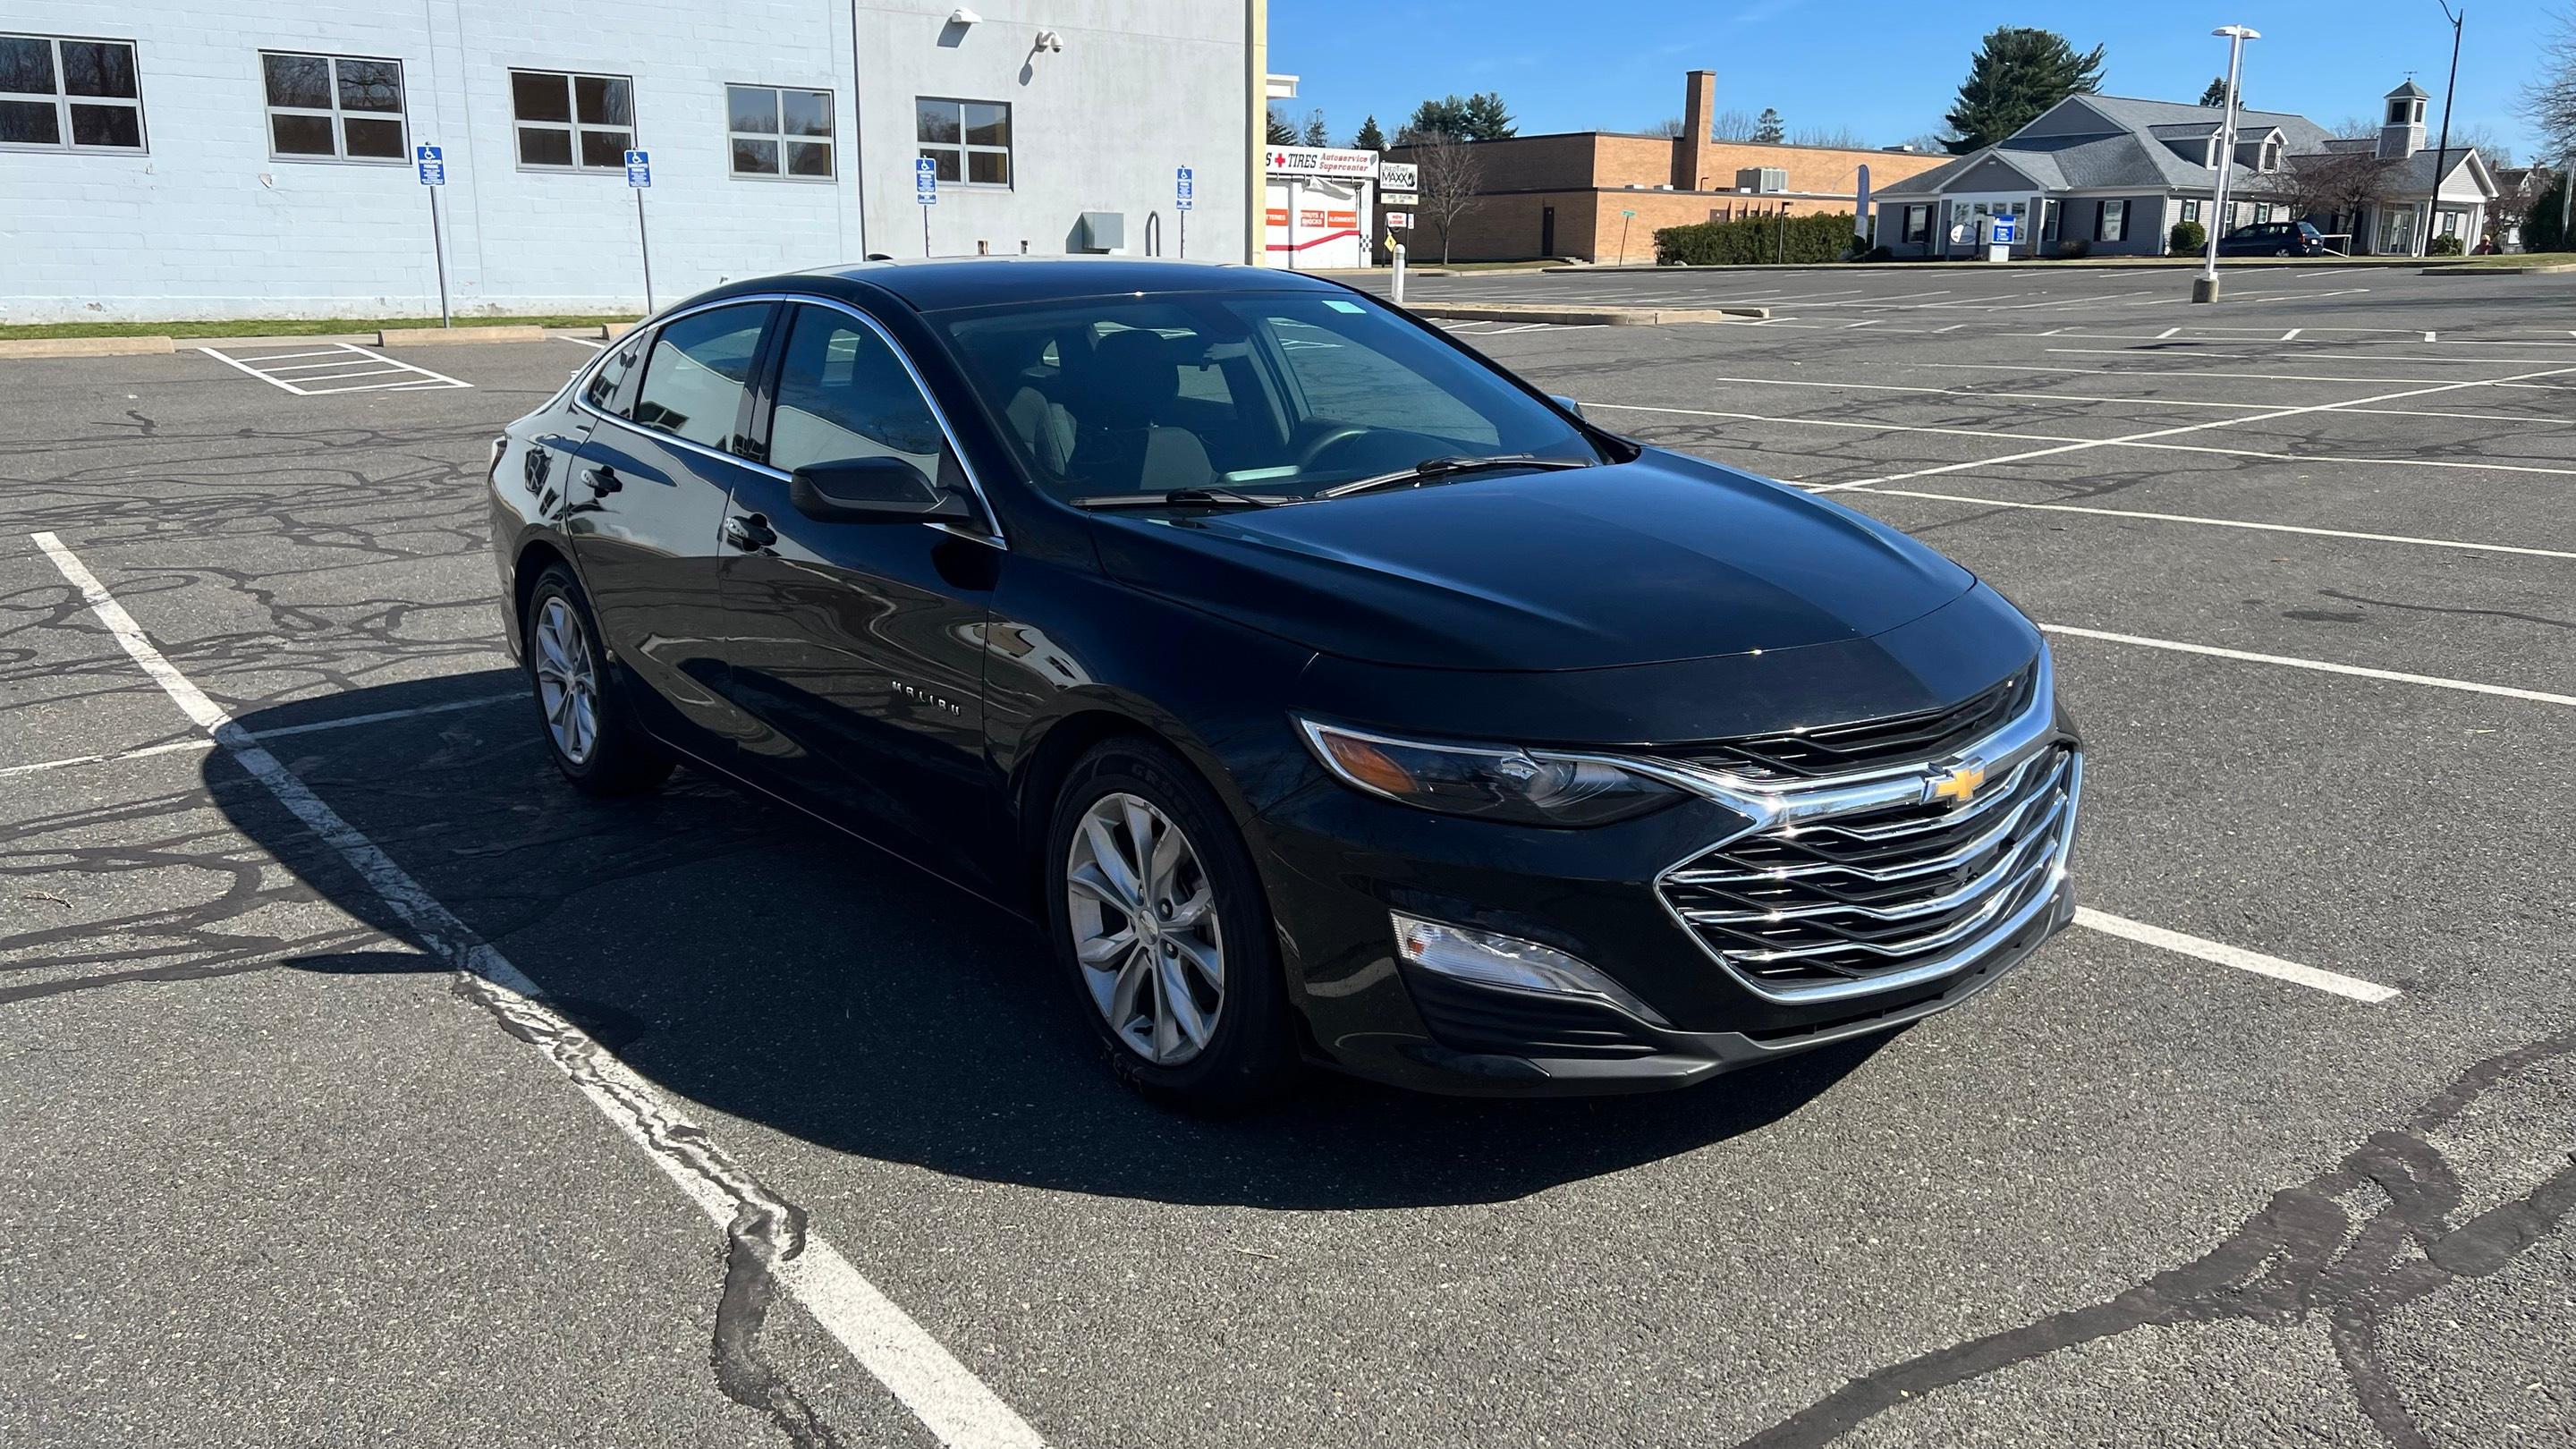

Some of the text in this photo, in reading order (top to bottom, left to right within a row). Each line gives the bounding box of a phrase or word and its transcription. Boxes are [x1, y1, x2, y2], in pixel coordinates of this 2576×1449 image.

[1287, 153, 1318, 168] TIRES
[1320, 152, 1368, 163] Autoservice
[1319, 161, 1368, 173] Supercenter
[1382, 171, 1410, 187] MAXX
[892, 681, 961, 716] MALIBU
